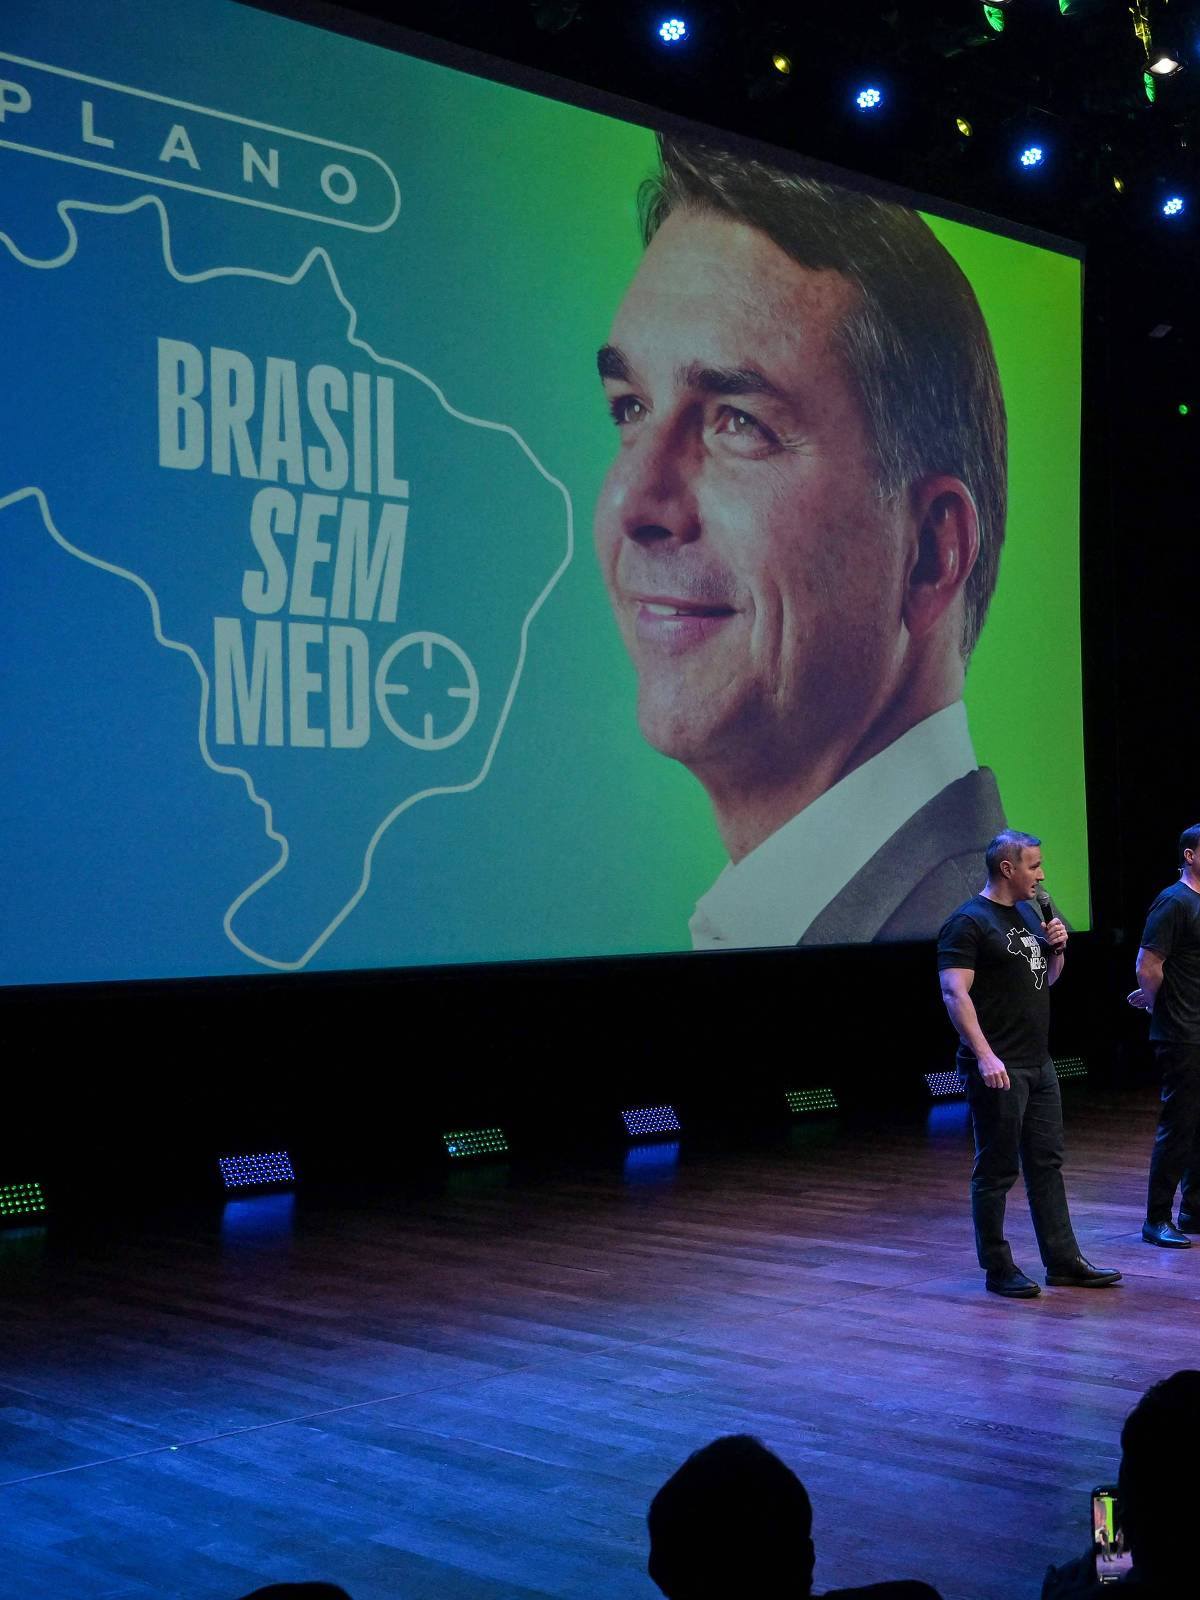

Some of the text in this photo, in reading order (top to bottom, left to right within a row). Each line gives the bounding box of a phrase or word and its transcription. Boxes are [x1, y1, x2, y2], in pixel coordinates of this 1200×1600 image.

[0, 80, 358, 205] PLANO
[157, 337, 409, 498] BRASIL
[241, 487, 409, 623] SEM
